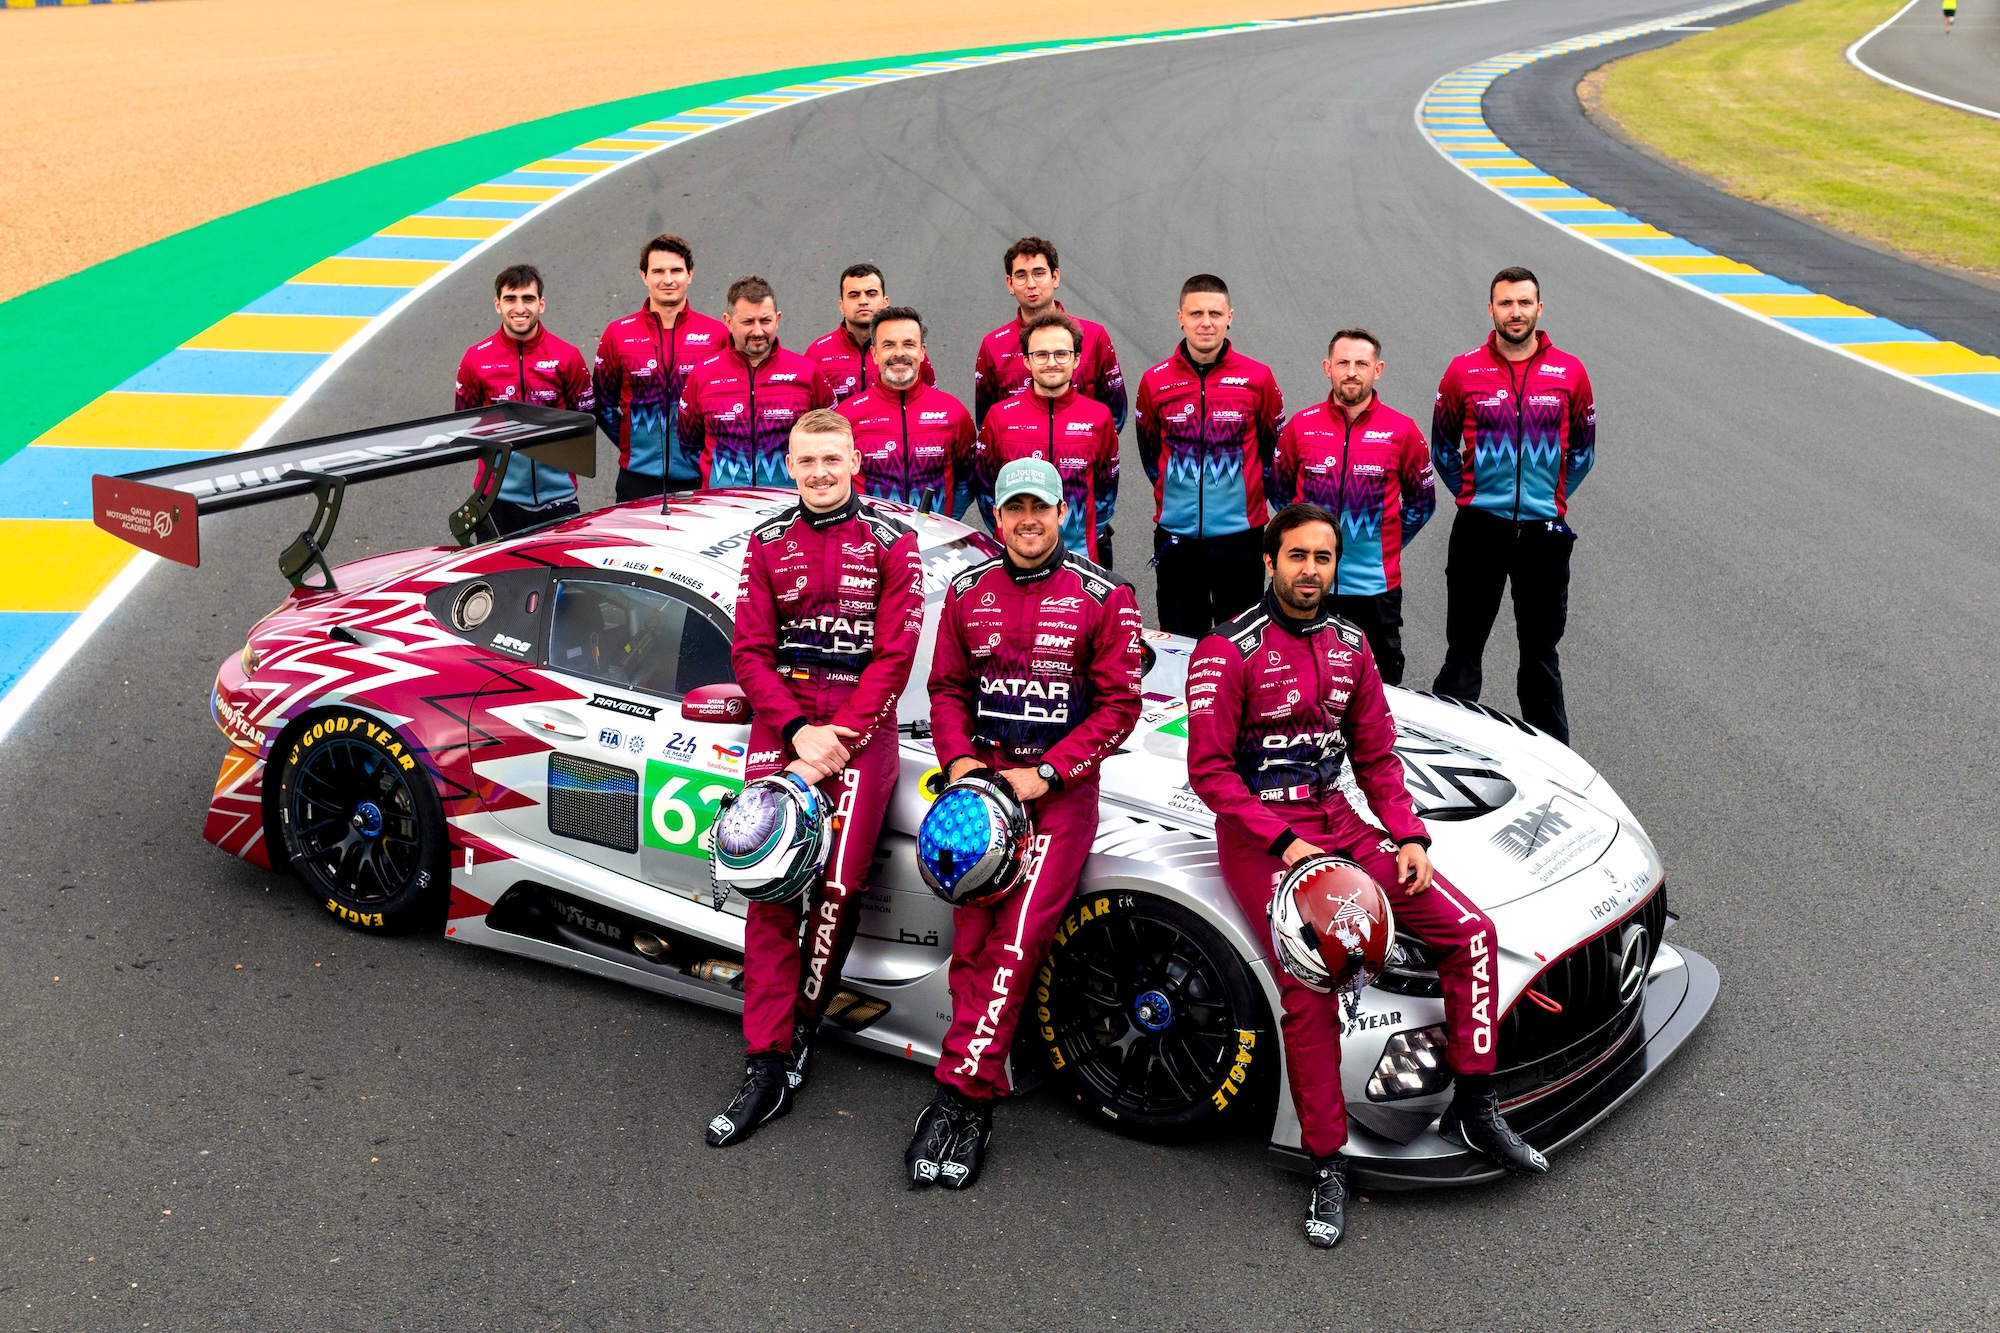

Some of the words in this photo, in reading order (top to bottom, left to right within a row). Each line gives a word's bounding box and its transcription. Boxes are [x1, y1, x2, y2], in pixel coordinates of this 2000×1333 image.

[106, 510, 151, 526] MOTORSPORTS
[129, 507, 151, 518] QATAR
[122, 522, 151, 534] ACADEMY
[762, 528, 780, 538] OMP
[876, 527, 893, 541] OMP
[623, 561, 648, 572] ALESI
[669, 572, 704, 590] HANSES
[956, 577, 972, 591] OMP
[1087, 582, 1106, 596] OMP
[781, 616, 875, 637] QATAR
[1038, 621, 1077, 630] GOODYEAR
[1240, 638, 1257, 650] OMP
[1343, 633, 1360, 645] OMP
[826, 673, 859, 682] J.HANSE
[980, 676, 1070, 700] QATAR
[594, 697, 655, 718] RAVENOL
[687, 703, 724, 711] MOTORSPORTS
[706, 699, 724, 707] QATAR
[600, 730, 619, 746] FIA
[672, 751, 692, 760] MANS
[1069, 760, 1092, 777] IRON
[1106, 729, 1126, 748] LYNX
[707, 762, 738, 774] TotalEnergies
[1260, 790, 1284, 800] OMP
[651, 776, 738, 851] 62
[1590, 895, 1619, 920] IRON
[1632, 872, 1650, 892] LYNX
[326, 898, 384, 926] EAGLE
[804, 901, 840, 1000] QATAR
[1470, 930, 1491, 1055] QATAR
[936, 1012, 952, 1022] IRO
[954, 966, 1014, 1076] QATAR
[1212, 1029, 1256, 1112] EAGLE
[920, 1163, 938, 1177] OM
